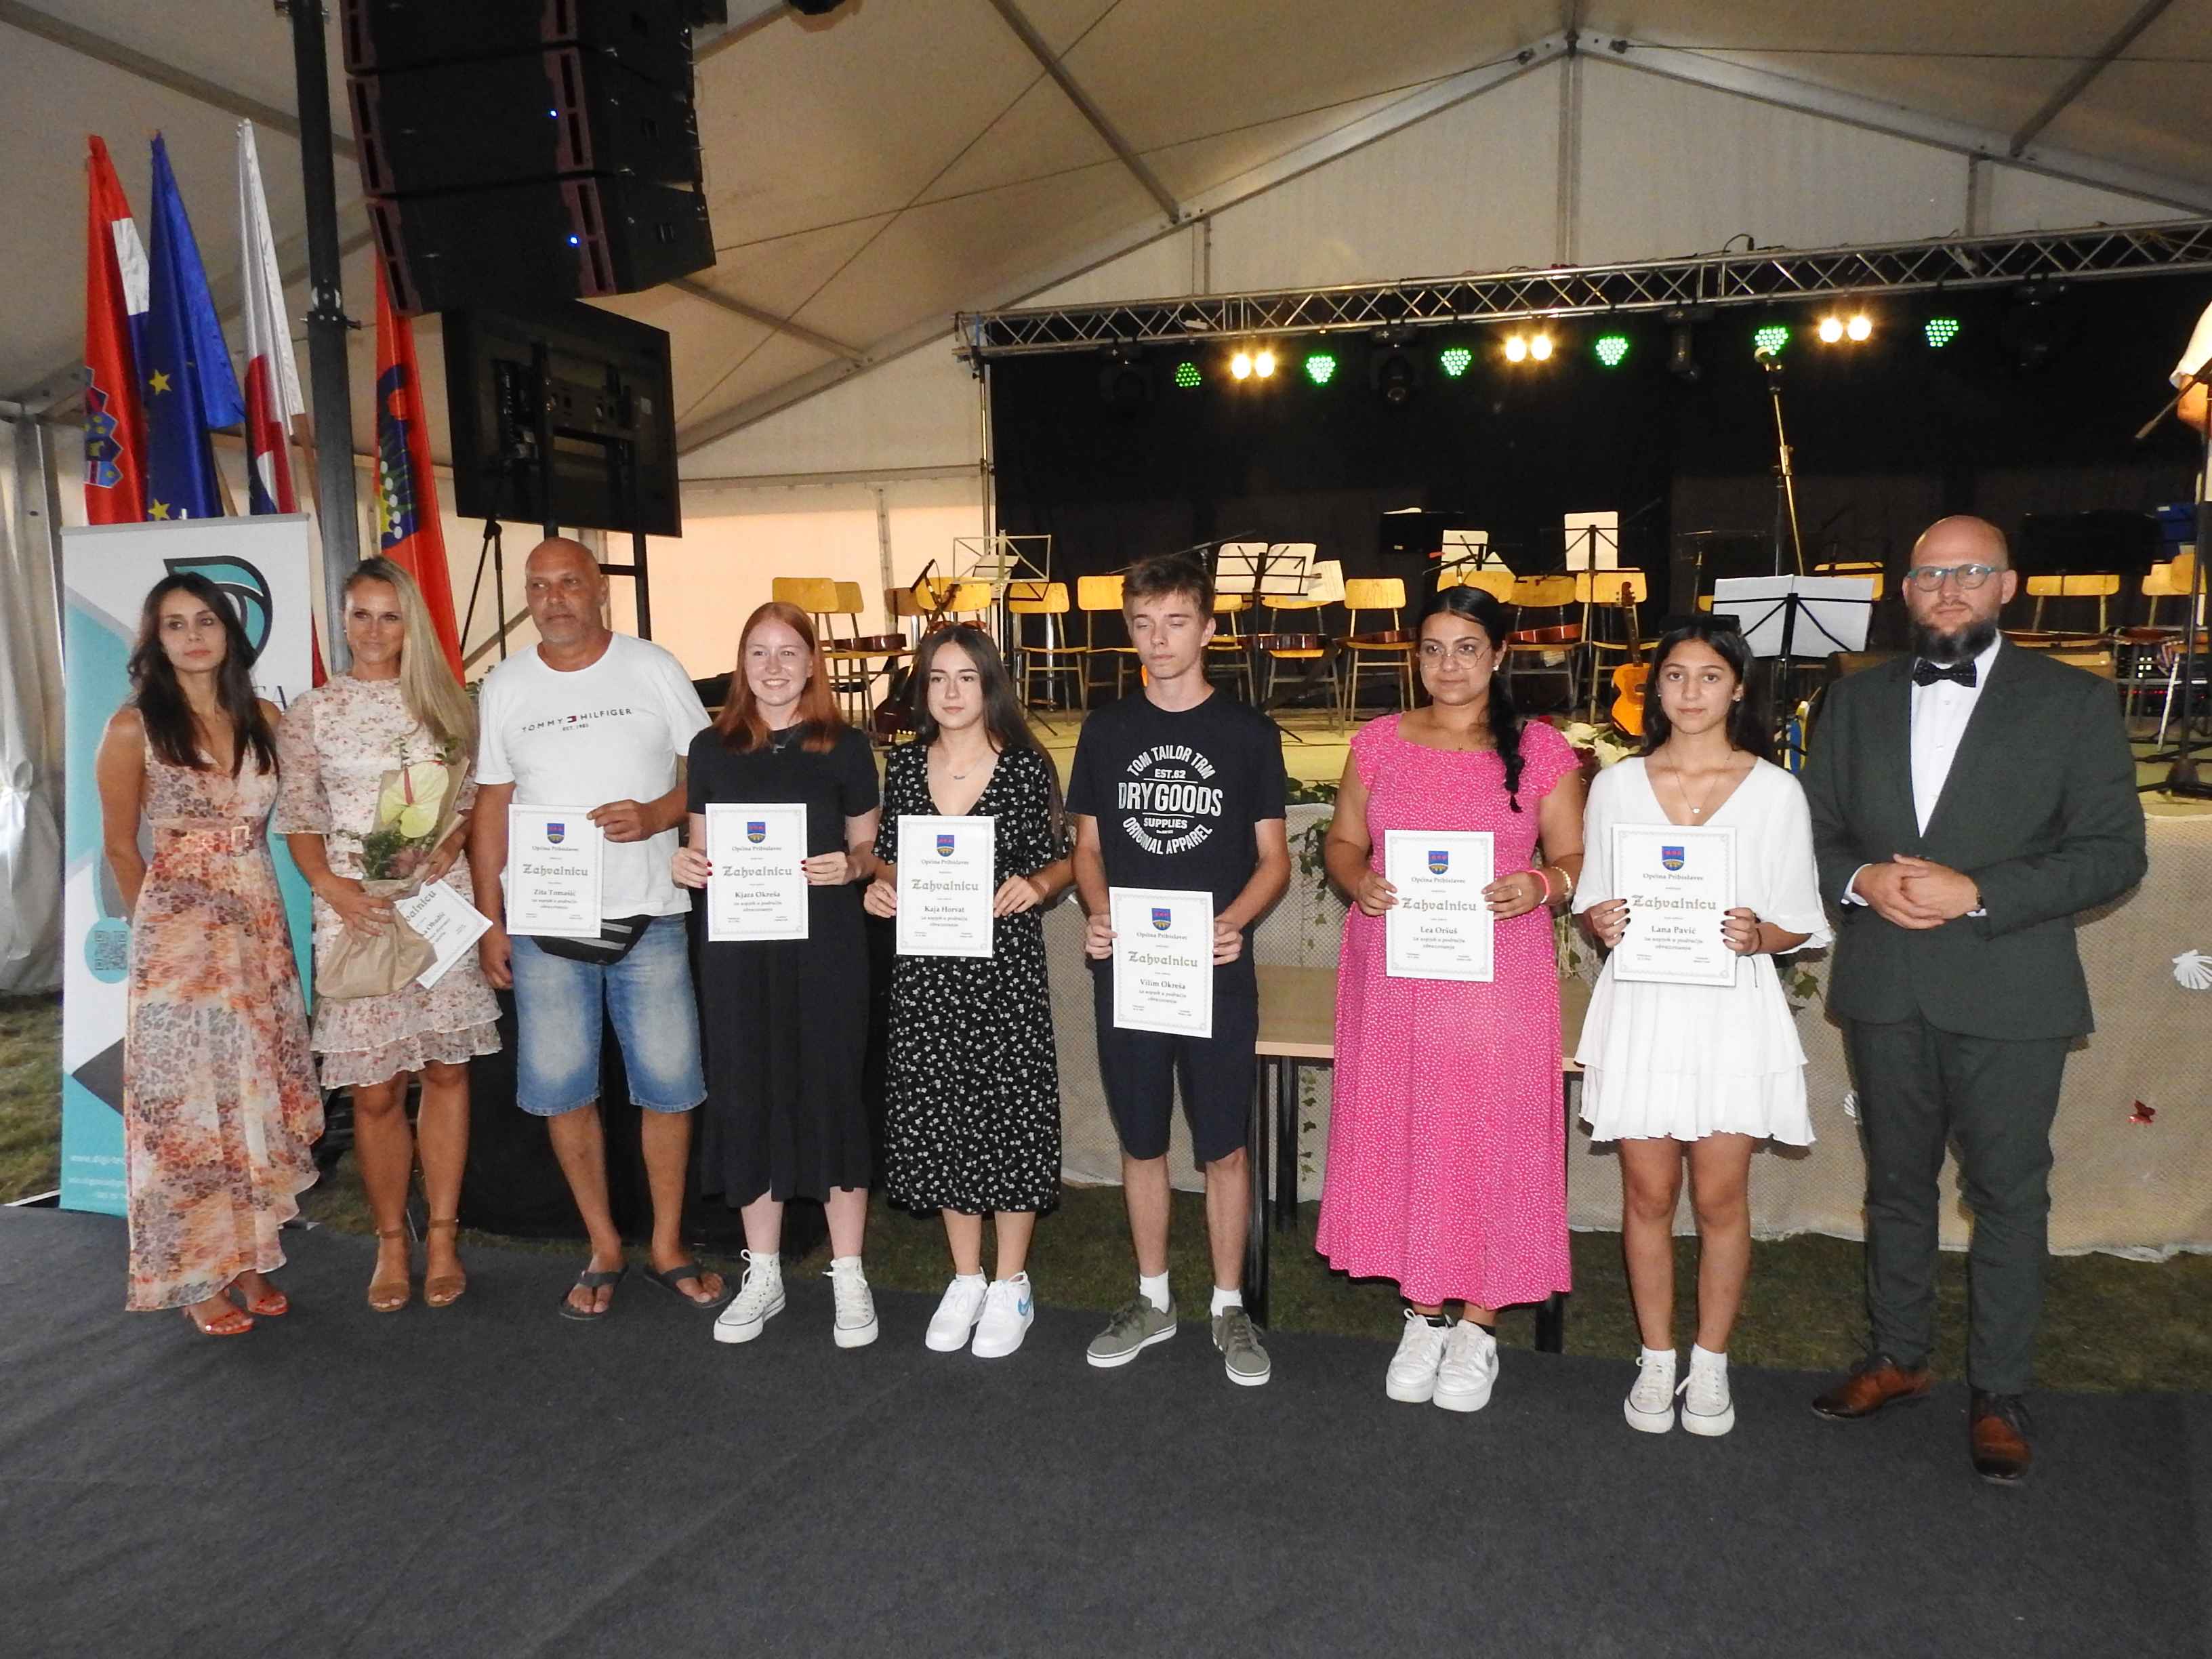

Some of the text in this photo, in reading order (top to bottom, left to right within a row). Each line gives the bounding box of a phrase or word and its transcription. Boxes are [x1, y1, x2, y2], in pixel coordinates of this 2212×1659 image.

[521, 708, 632, 733] TOMMY HILFIGER
[1126, 745, 1216, 780] TOM TAILOR TRM
[1154, 769, 1186, 779] EST.62
[1118, 782, 1223, 817] DRY GOODS
[1143, 817, 1188, 830] SUPPLIES
[1166, 823, 1213, 855] APPAREL
[523, 864, 588, 877] Zahvalnicu
[722, 865, 792, 878] Zahvalnicu
[911, 878, 979, 893] Zahvalnicu
[406, 890, 437, 922] valnicu
[1401, 897, 1477, 912] Zahvalnicu
[1631, 895, 1717, 910] Zahvalnicu
[1652, 925, 1671, 934] Lana
[1128, 950, 1198, 967] Zahvalnicu
